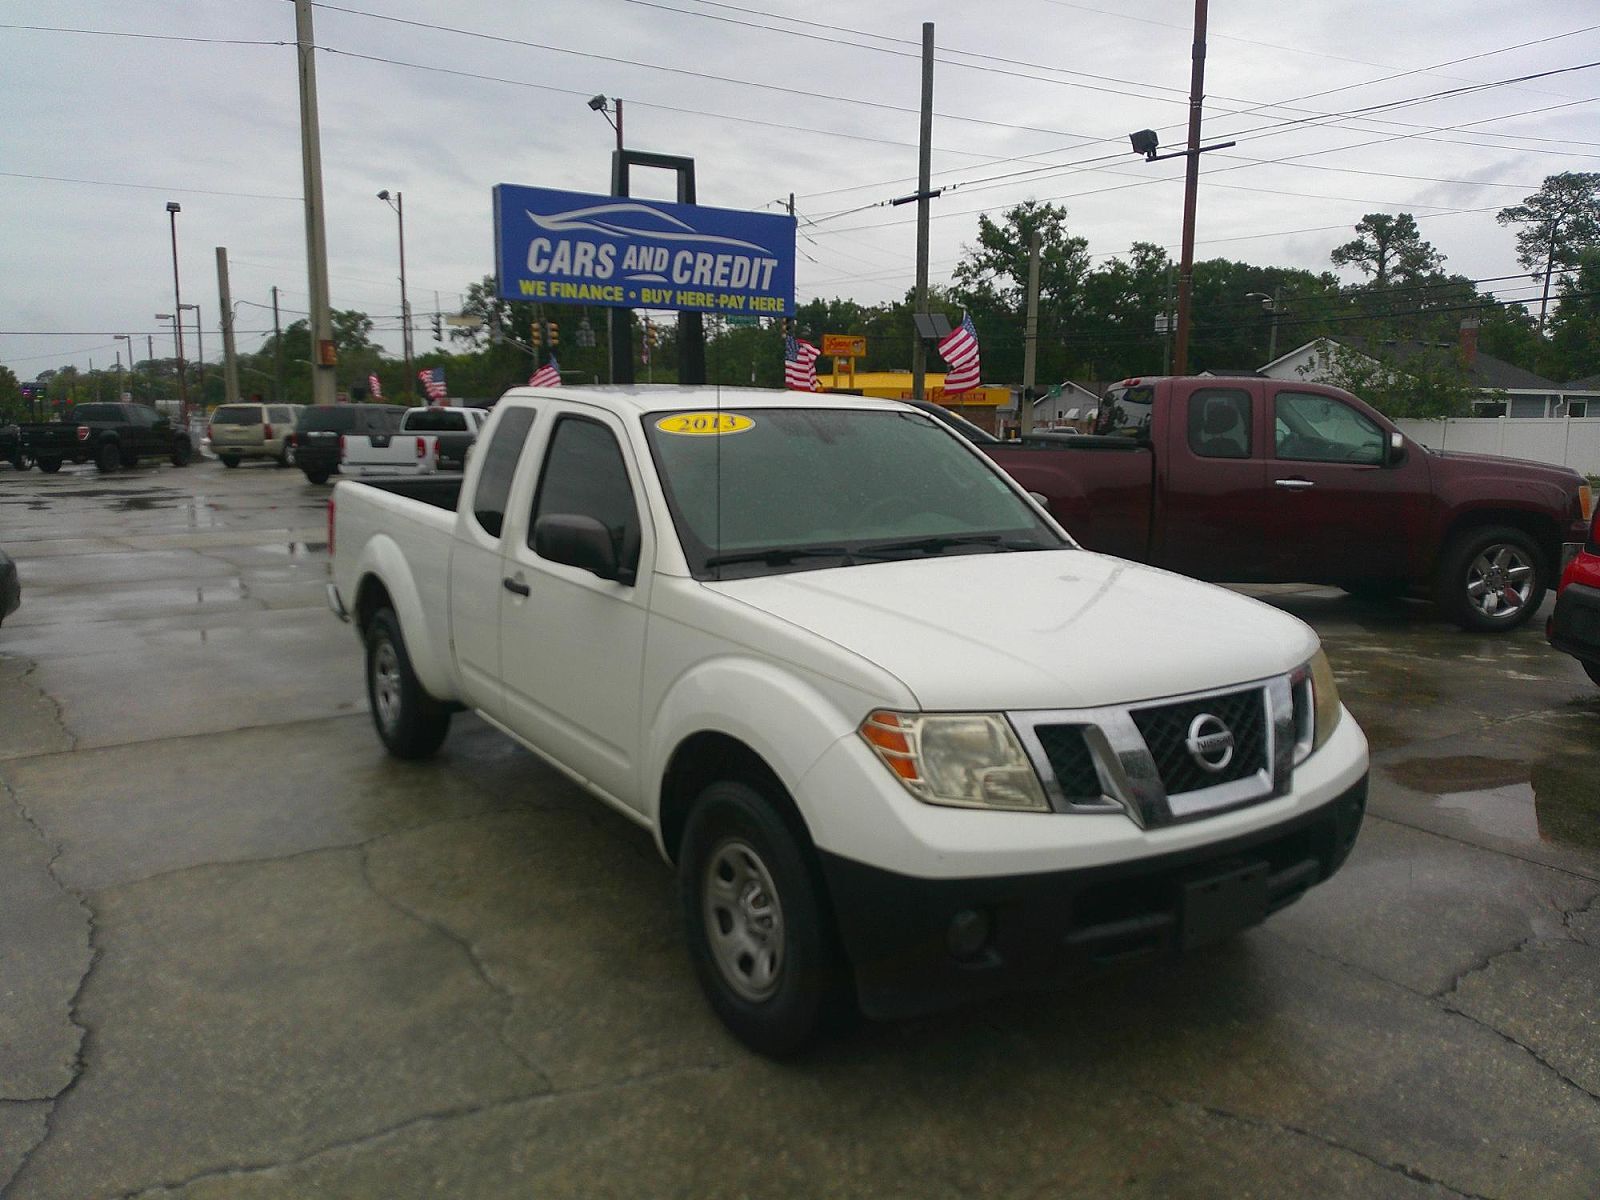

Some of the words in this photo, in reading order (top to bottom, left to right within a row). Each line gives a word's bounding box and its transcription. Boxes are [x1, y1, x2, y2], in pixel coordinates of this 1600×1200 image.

[527, 237, 617, 279] CARS
[621, 245, 670, 273] AND
[672, 250, 778, 290] CREDIT
[519, 280, 547, 297] WE
[549, 282, 625, 302] FINANCE
[641, 288, 673, 304] BUY
[748, 296, 785, 312] HERE
[678, 415, 737, 433] 2013
